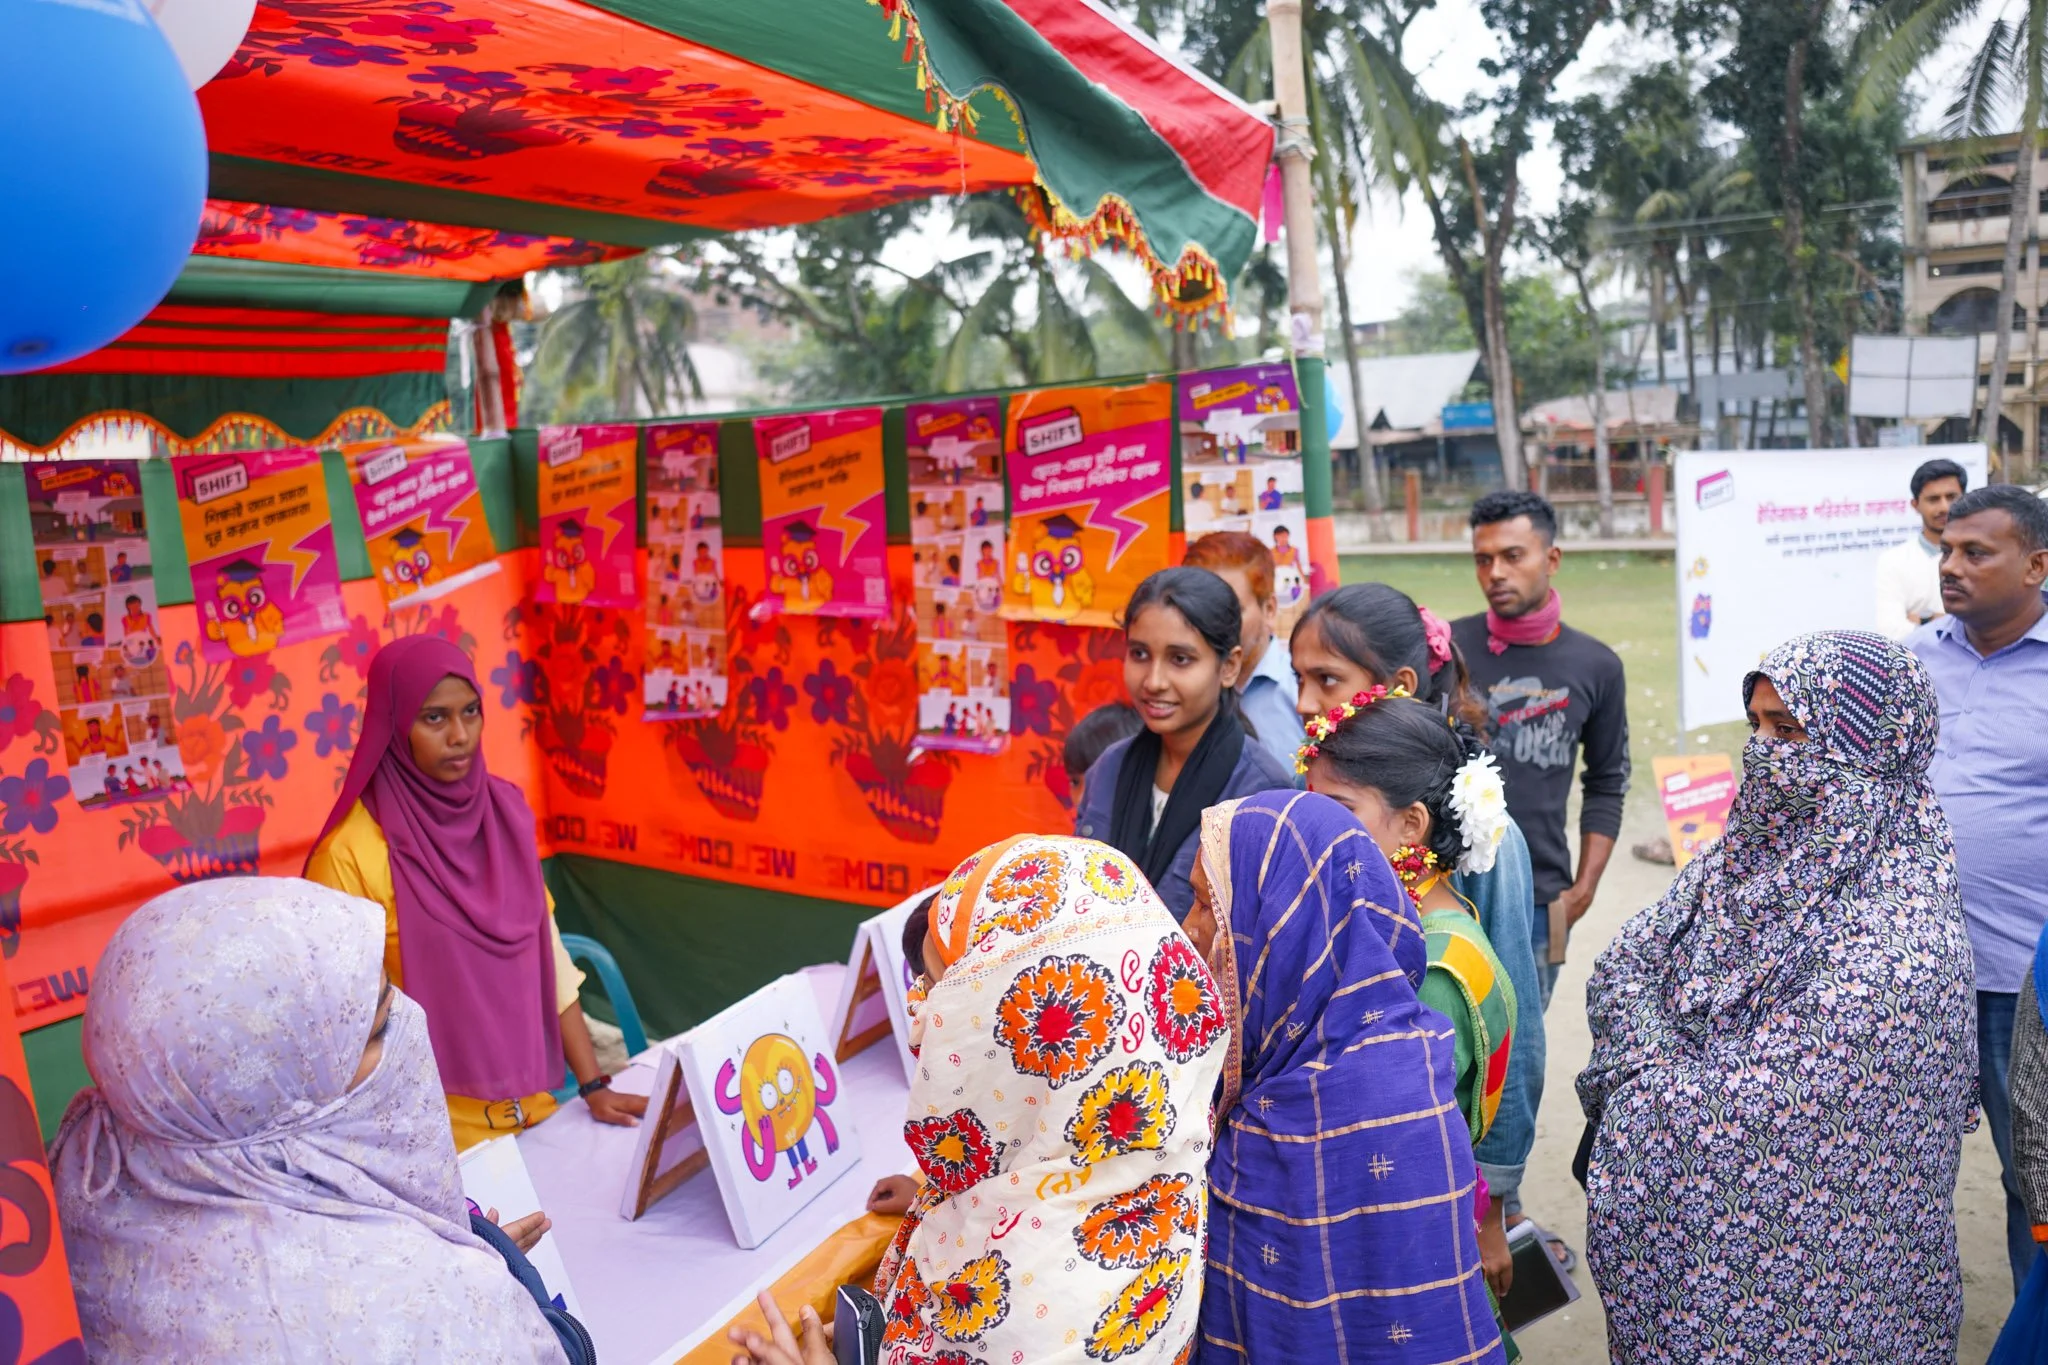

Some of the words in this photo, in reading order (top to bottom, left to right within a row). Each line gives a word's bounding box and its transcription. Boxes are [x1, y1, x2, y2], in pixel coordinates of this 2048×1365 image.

[775, 433, 806, 456] SHIFT
[1030, 424, 1077, 448] SHIFT
[198, 471, 242, 496] SHIFT
